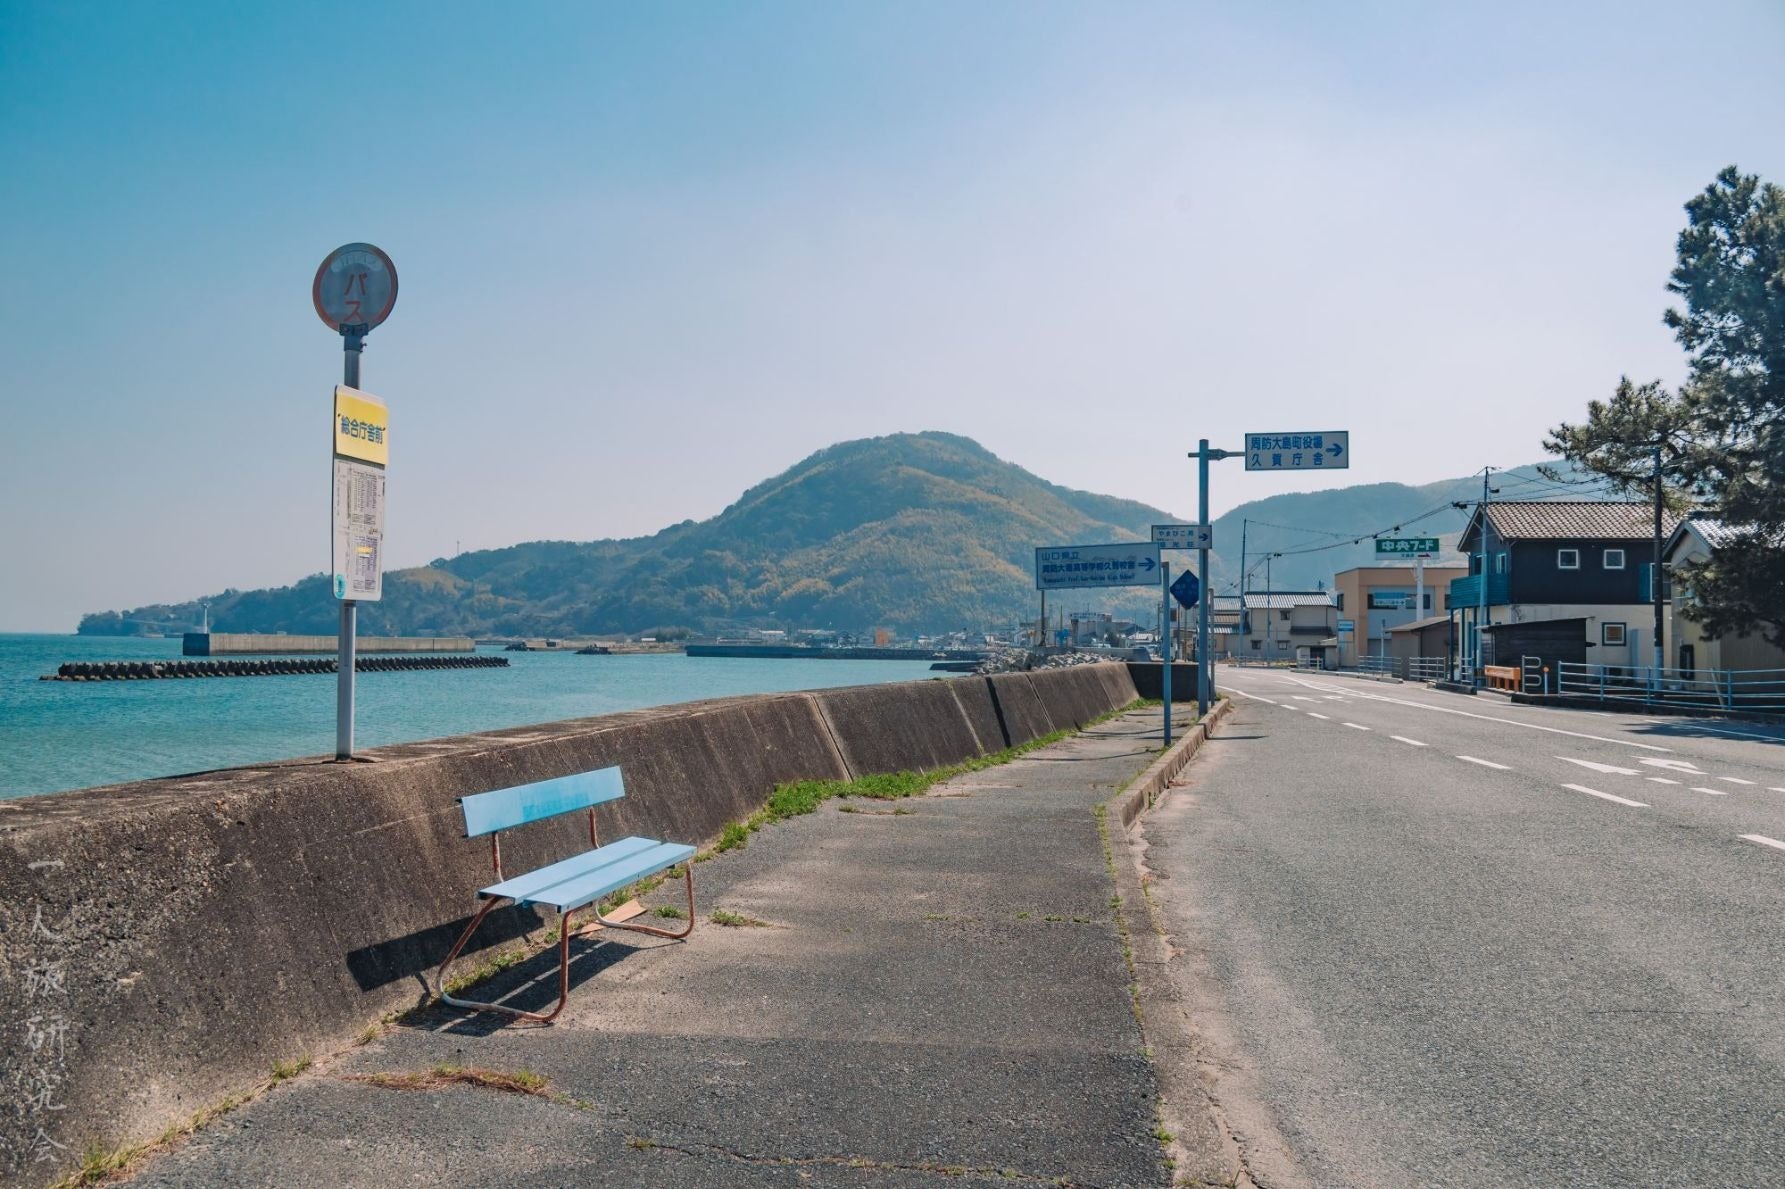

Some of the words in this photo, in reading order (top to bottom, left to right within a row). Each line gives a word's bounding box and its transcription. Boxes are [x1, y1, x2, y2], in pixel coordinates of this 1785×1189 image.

[344, 272, 368, 322] バス
[341, 415, 383, 444] 総合庁舎前
[1250, 436, 1323, 450] 周防大島町役場
[1251, 452, 1324, 466] 久賀庁舎
[1381, 540, 1434, 551] 中央フード
[1041, 551, 1080, 561] 山口県立
